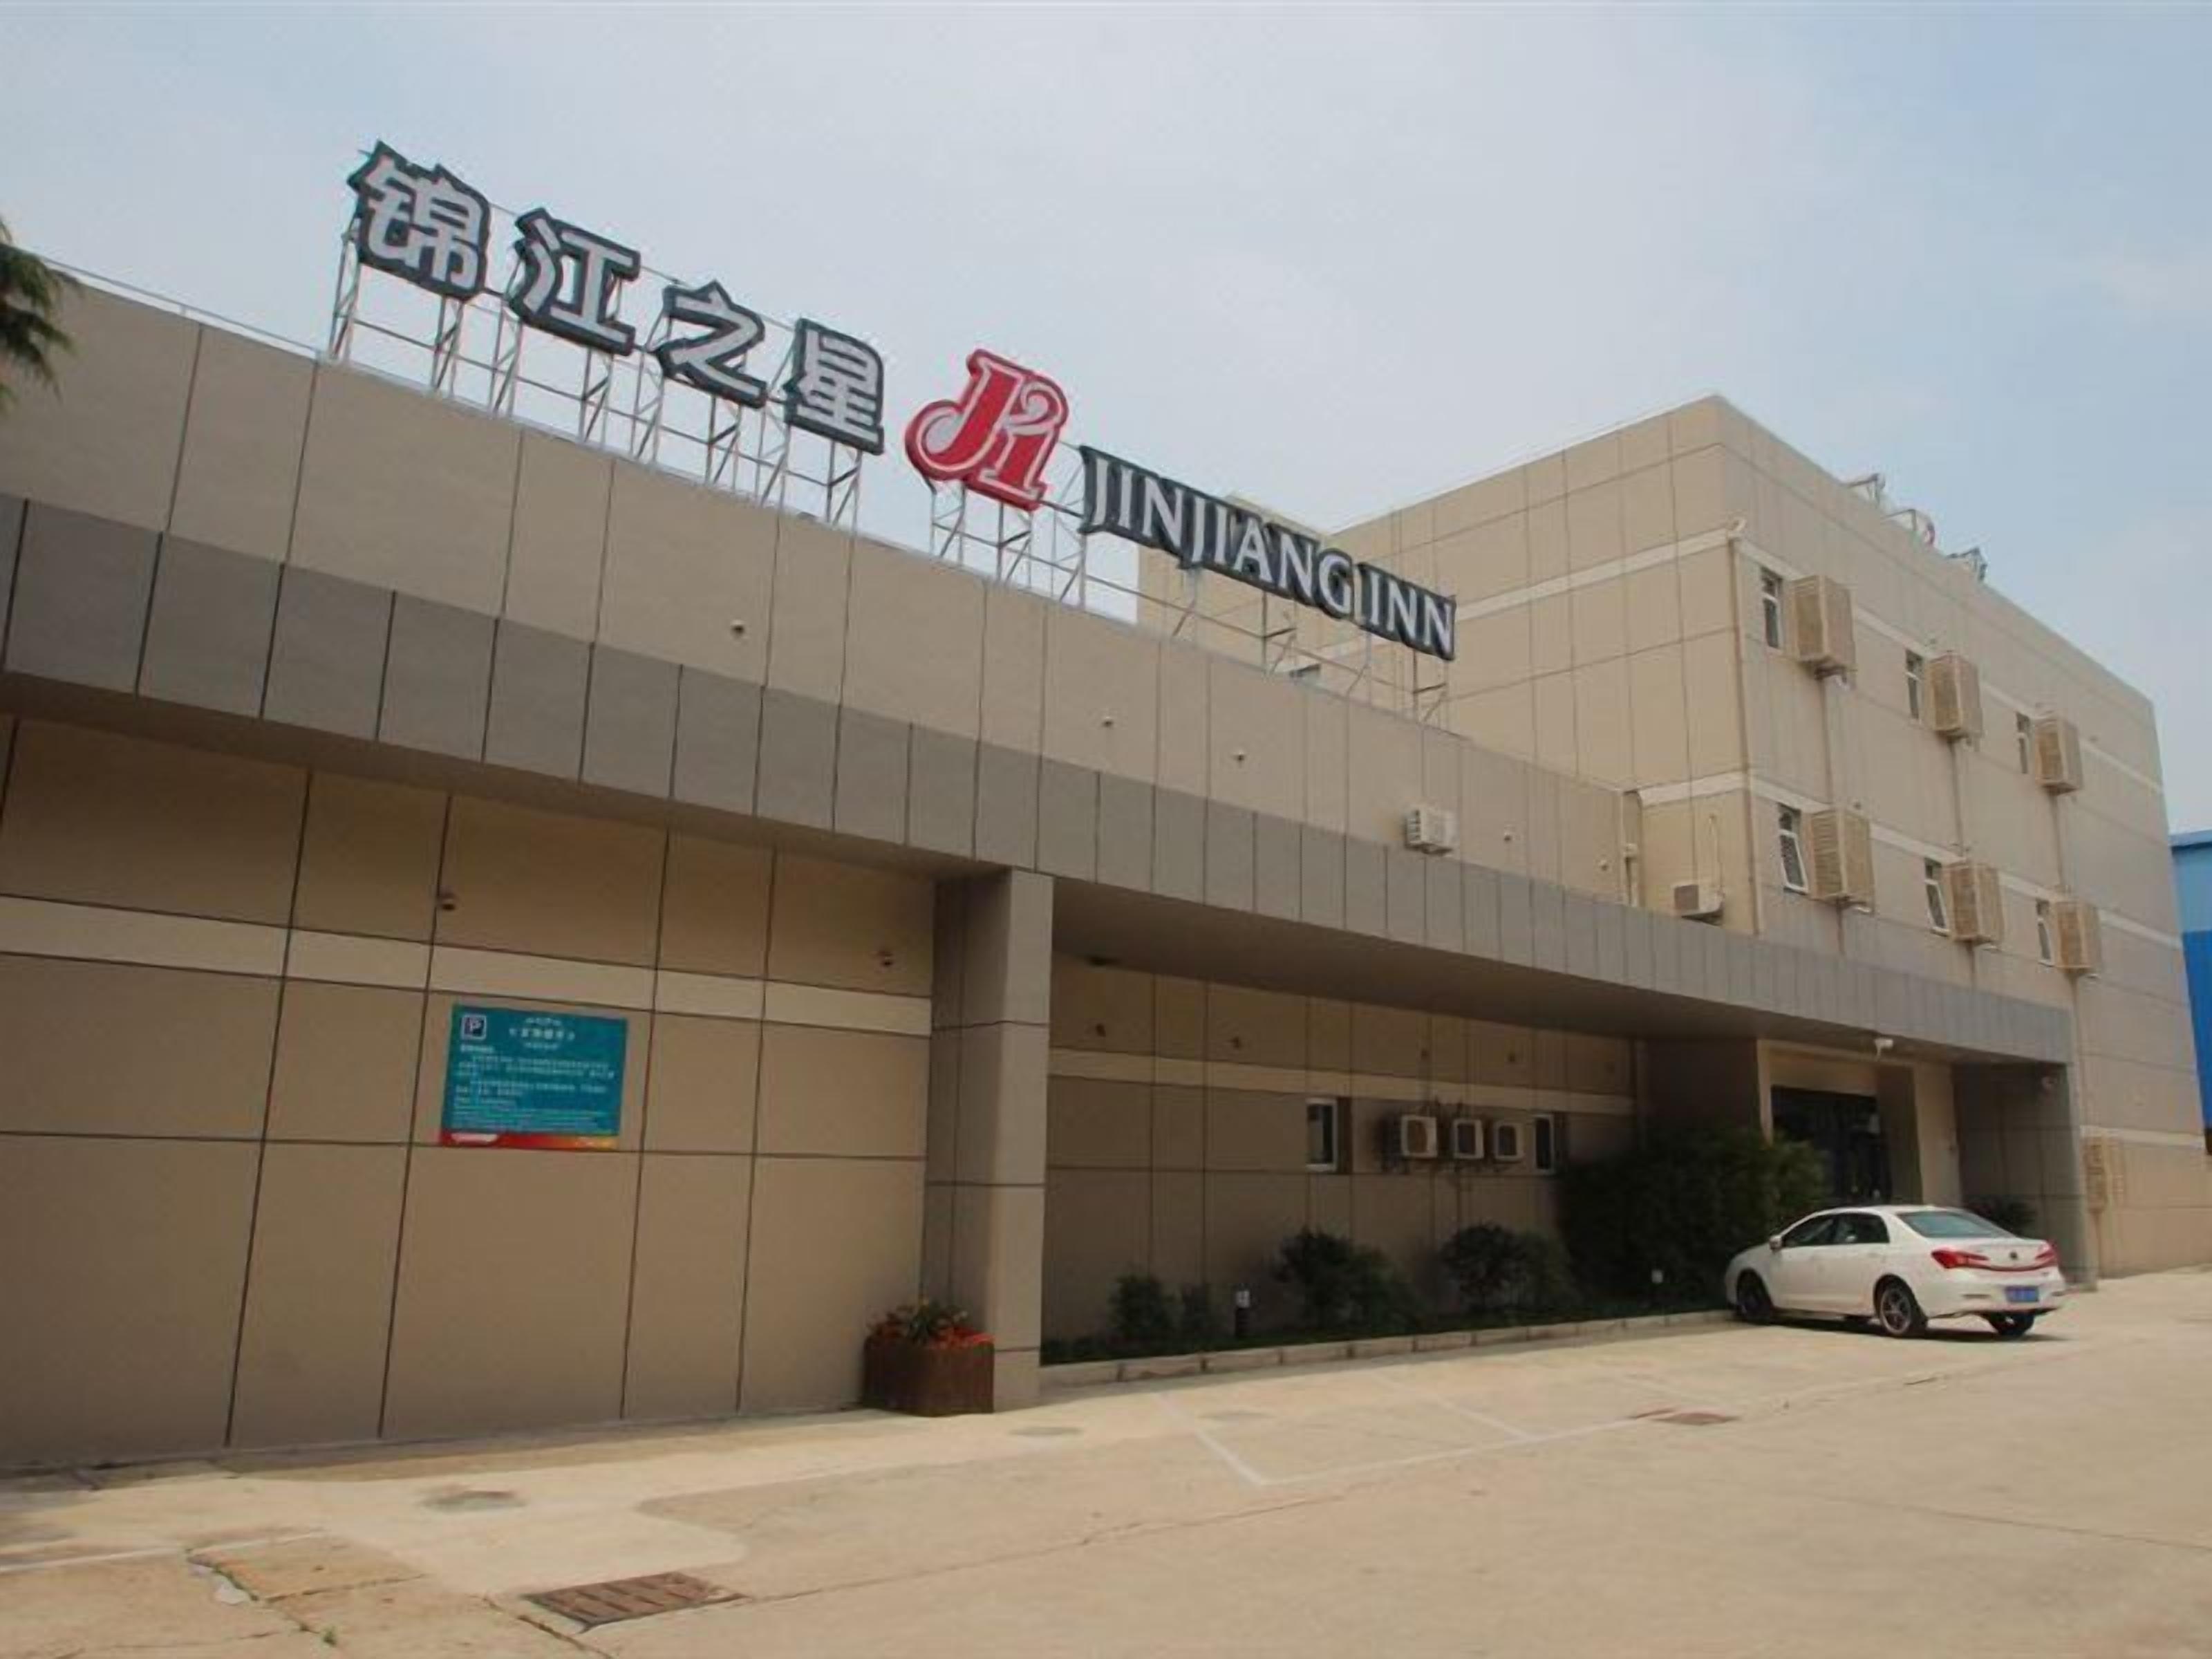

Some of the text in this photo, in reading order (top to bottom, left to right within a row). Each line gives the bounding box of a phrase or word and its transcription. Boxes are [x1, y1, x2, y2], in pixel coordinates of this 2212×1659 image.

[350, 143, 884, 453] 锦江之星
[1082, 449, 1455, 658] JINJIANG INN
